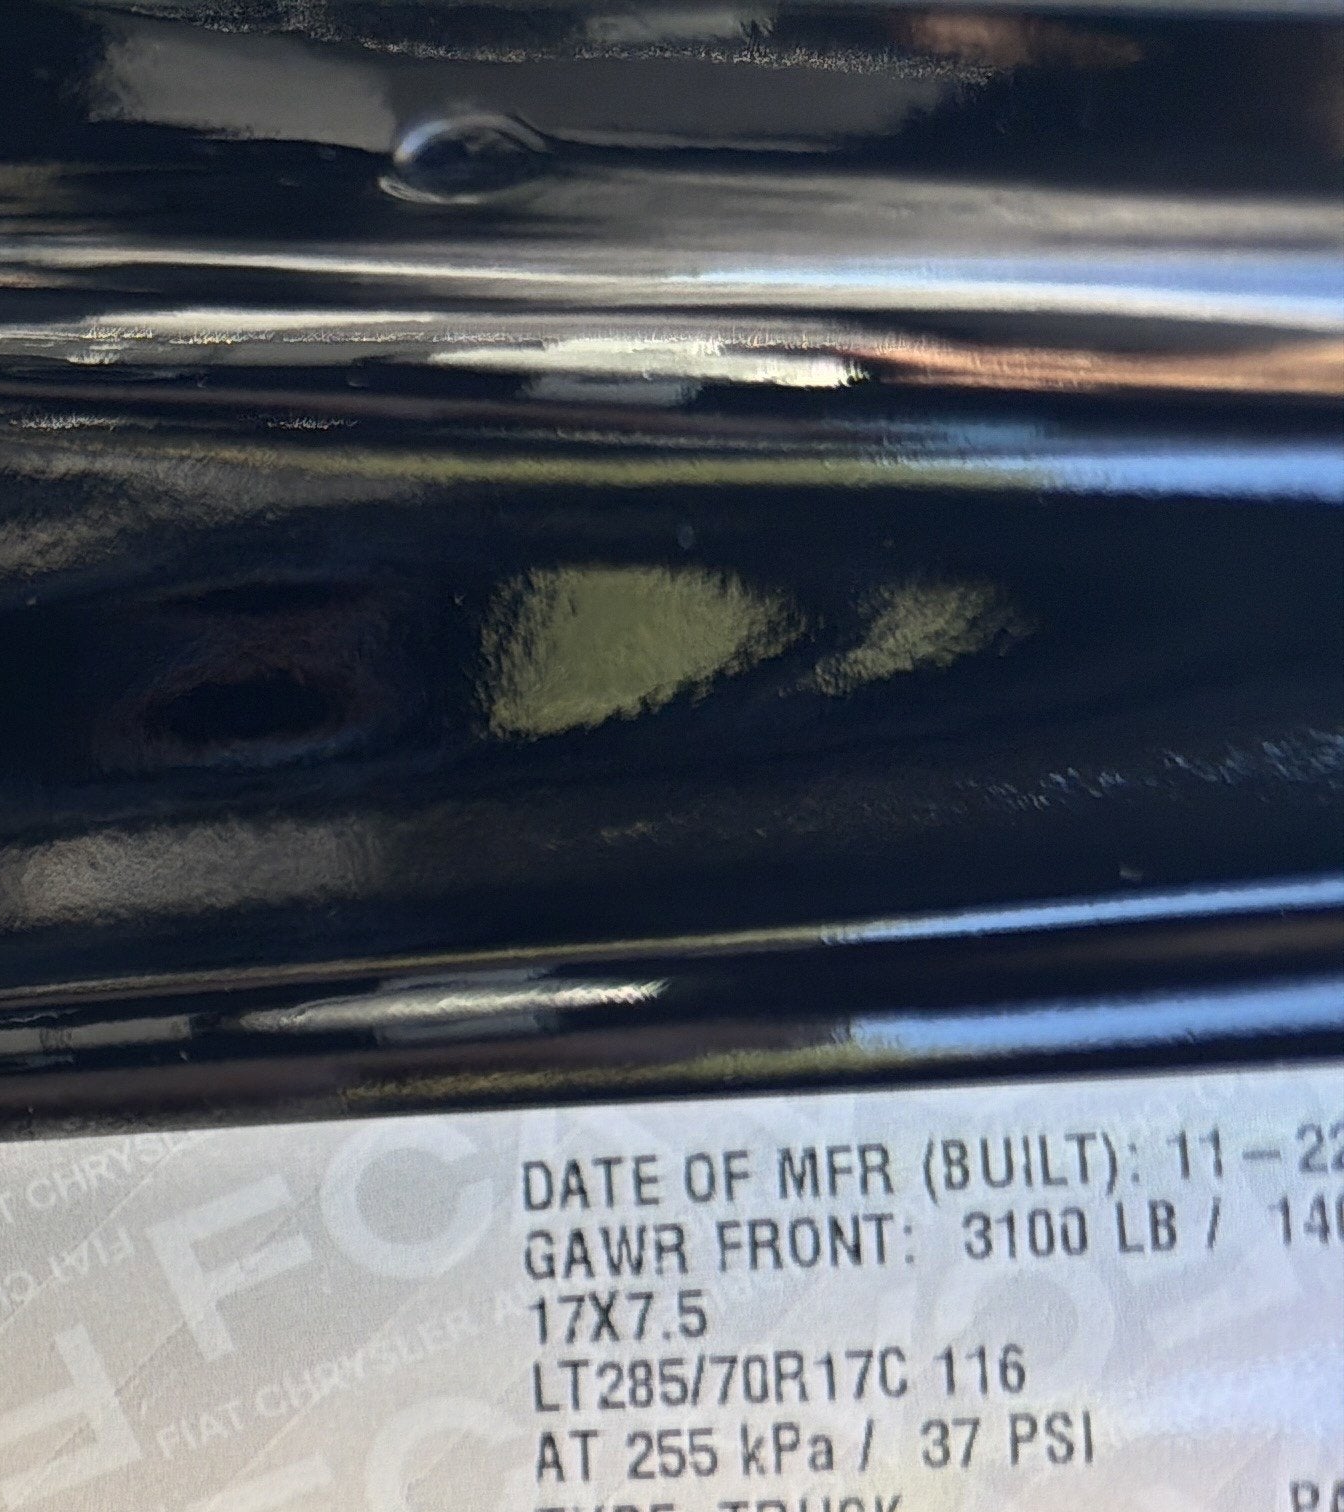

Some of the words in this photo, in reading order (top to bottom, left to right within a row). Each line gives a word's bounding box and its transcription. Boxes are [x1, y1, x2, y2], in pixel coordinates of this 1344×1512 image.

[523, 1155, 659, 1211] DATE
[685, 1150, 750, 1203] OF
[779, 1143, 894, 1199] MFR
[923, 1129, 1139, 1203] (BUILT):
[525, 1223, 688, 1280] GAWR
[717, 1213, 913, 1272] FRONT:
[963, 1207, 1088, 1259] 3100
[1116, 1200, 1176, 1253] LB
[531, 1289, 707, 1344] 17X7.5
[533, 1348, 909, 1413] LT285/70R17C
[938, 1343, 1025, 1395] 116
[537, 1430, 598, 1482] AT
[627, 1427, 718, 1480] 255
[741, 1422, 834, 1475] kPa
[921, 1417, 980, 1468] 37
[1010, 1411, 1093, 1466] PSI
